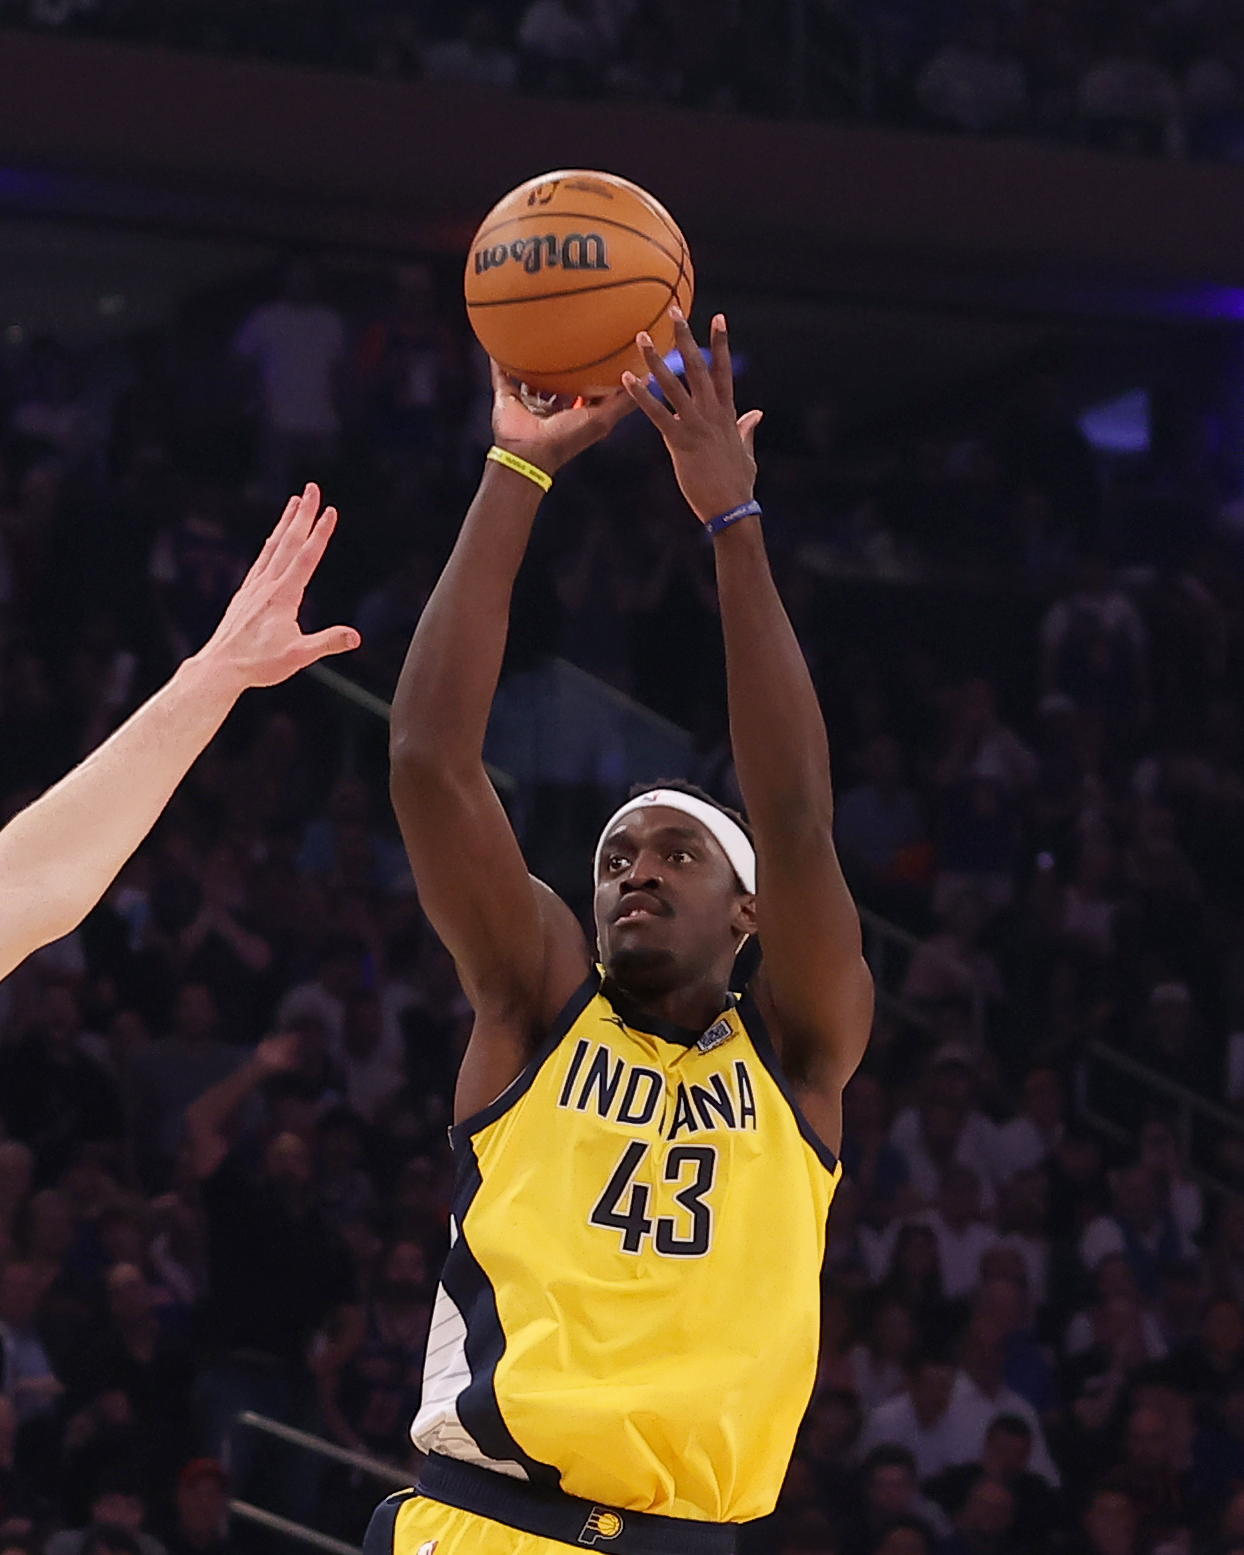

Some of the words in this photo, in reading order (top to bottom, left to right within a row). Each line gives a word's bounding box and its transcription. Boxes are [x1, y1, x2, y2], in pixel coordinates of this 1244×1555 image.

[474, 232, 610, 276] Wilson
[556, 1037, 758, 1141] INDANA
[588, 1139, 720, 1259] 43
